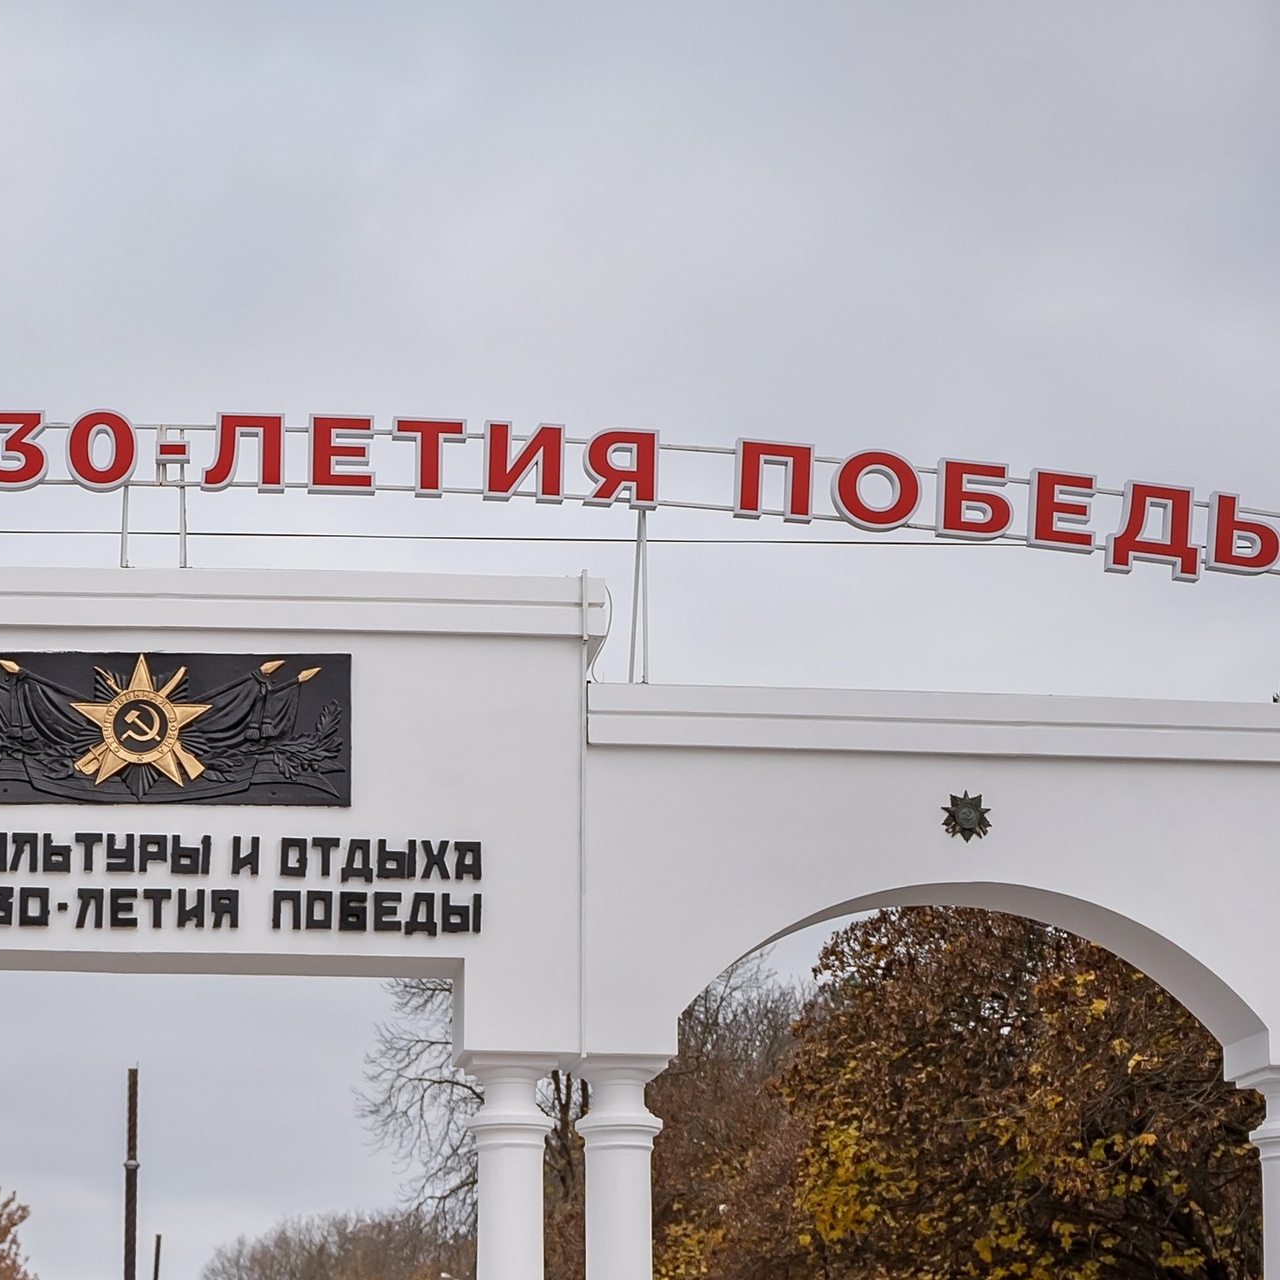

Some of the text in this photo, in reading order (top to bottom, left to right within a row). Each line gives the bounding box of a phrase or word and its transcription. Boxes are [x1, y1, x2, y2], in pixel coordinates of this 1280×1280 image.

[231, 835, 260, 877] И
[280, 837, 483, 884] ОТДЫХА
[272, 889, 482, 938] ПОБЕДЫ
